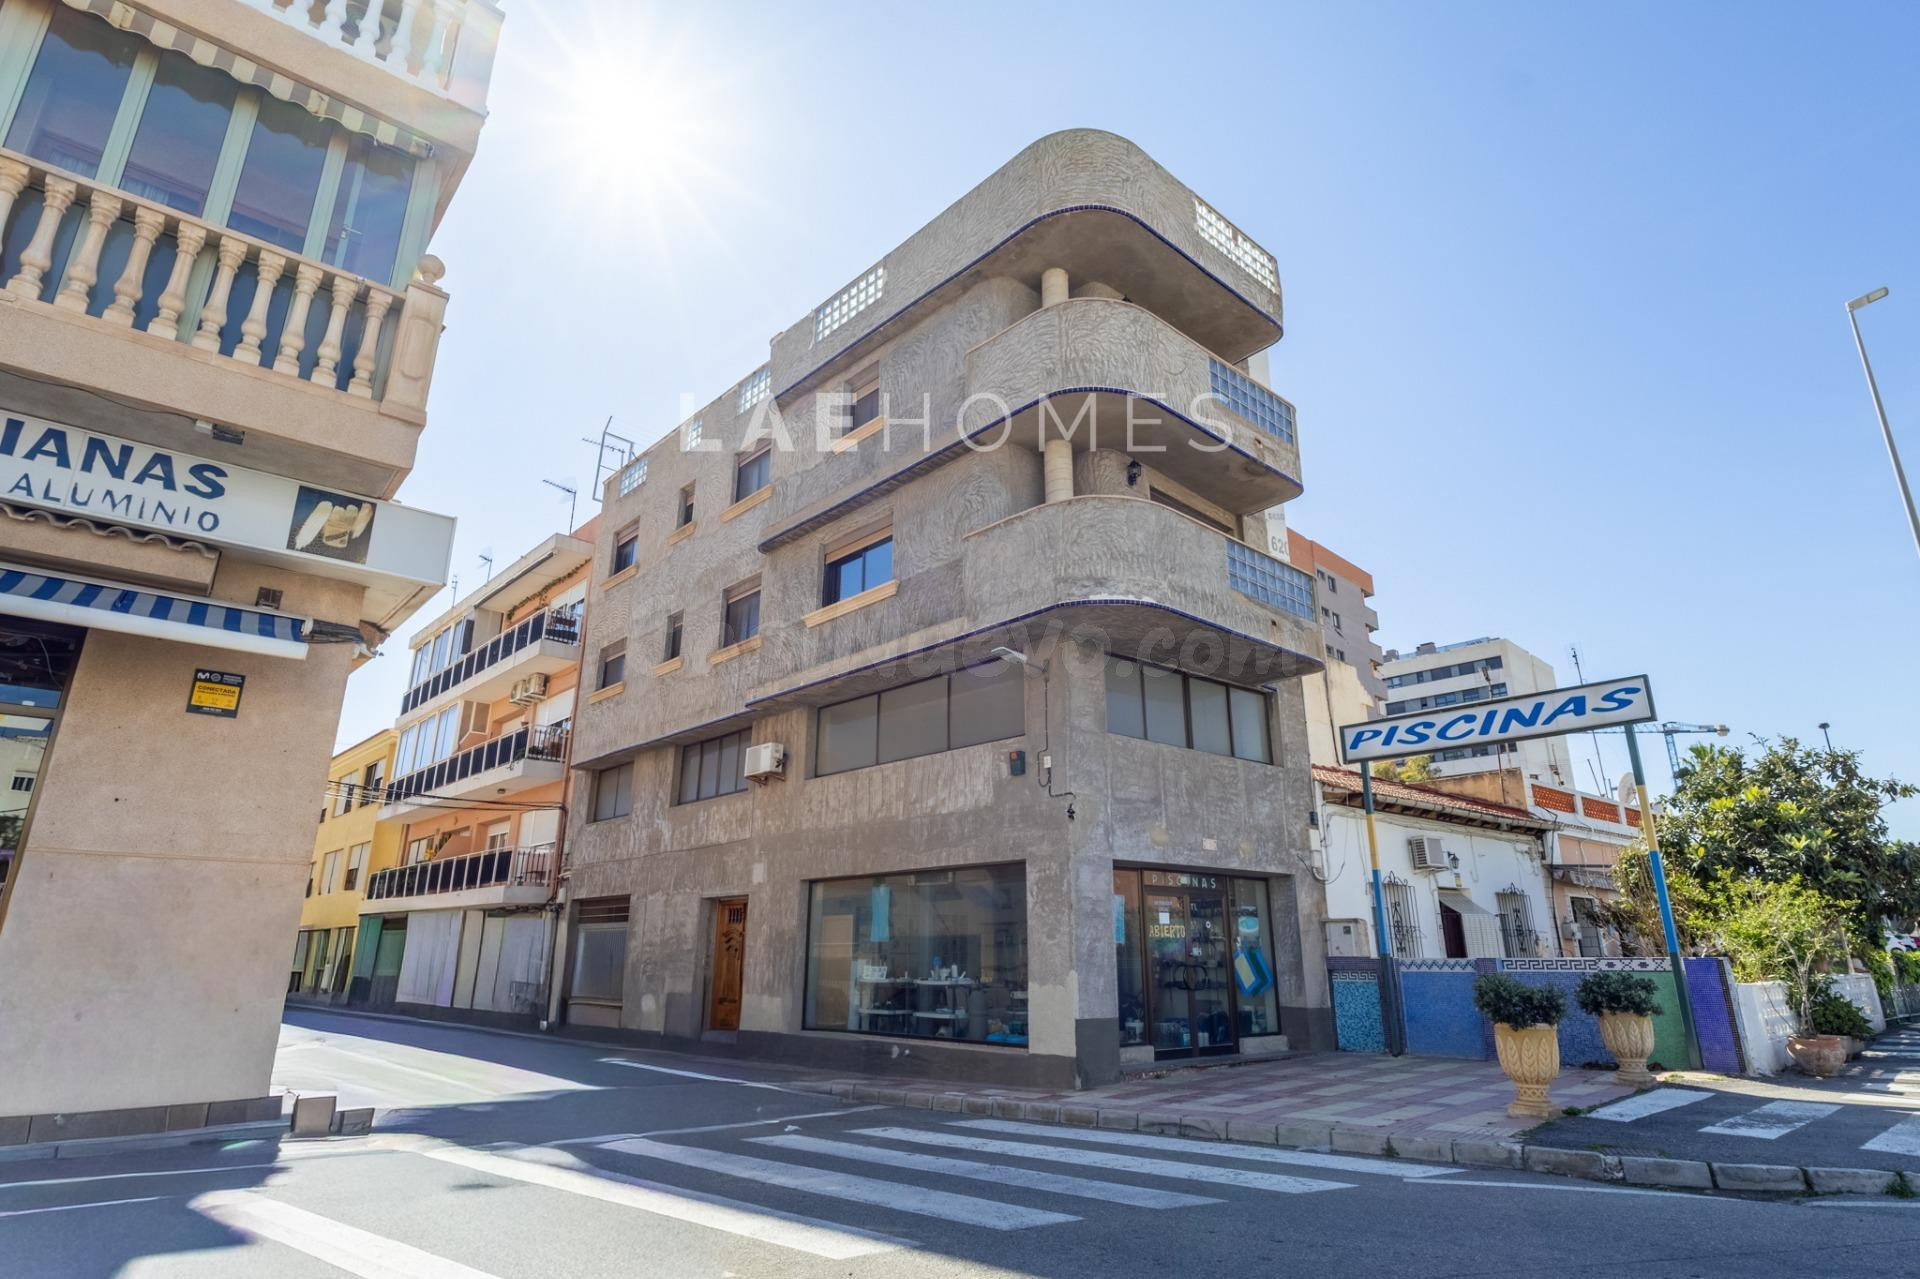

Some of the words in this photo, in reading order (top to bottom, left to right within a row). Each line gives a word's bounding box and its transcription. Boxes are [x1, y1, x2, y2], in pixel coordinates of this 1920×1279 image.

[8, 472, 221, 533] ALUMINIO
[1350, 686, 1642, 750] PISCINAS
[1149, 924, 1186, 938] ABIERTO
